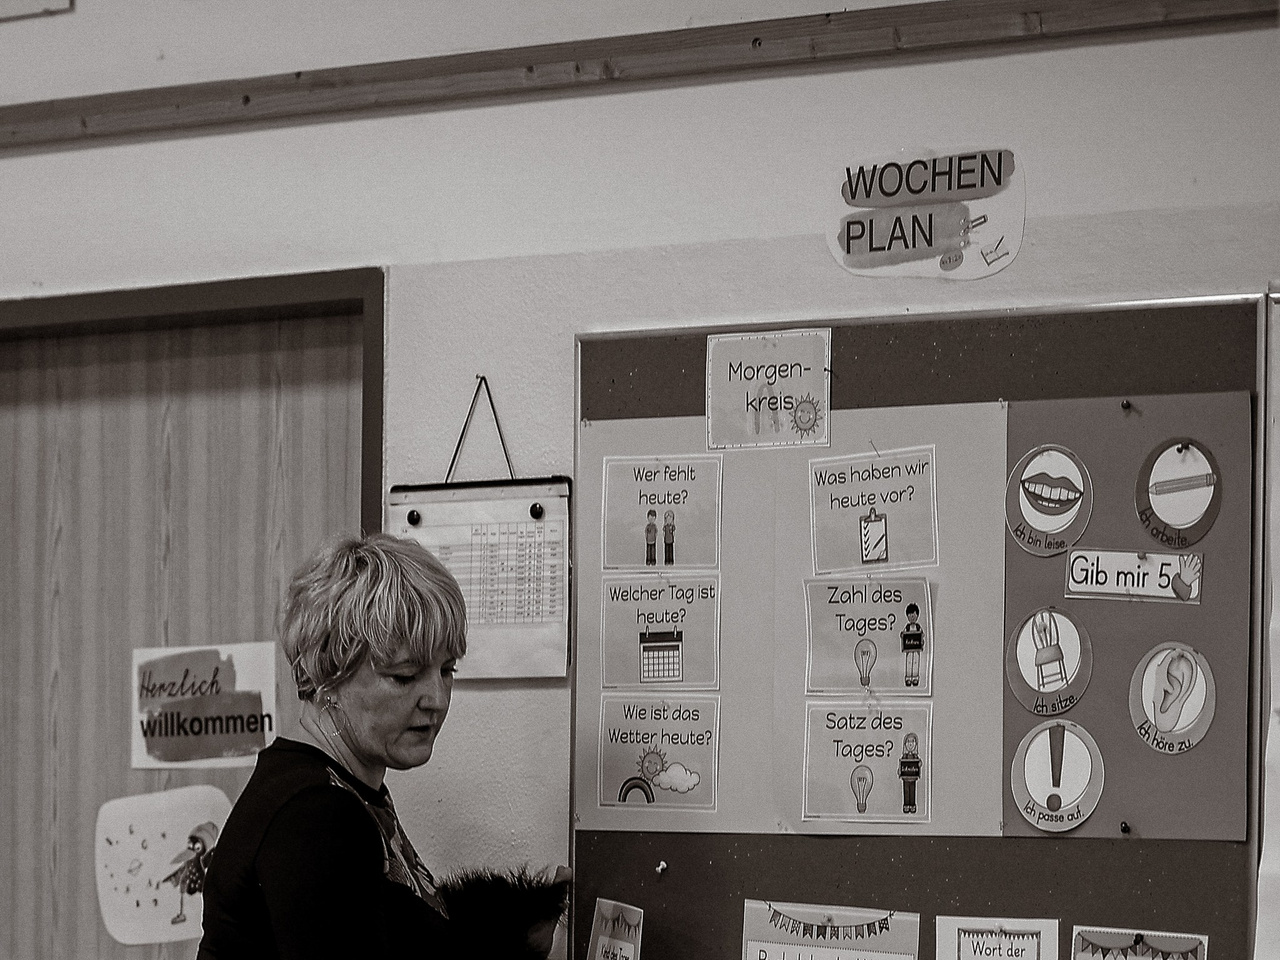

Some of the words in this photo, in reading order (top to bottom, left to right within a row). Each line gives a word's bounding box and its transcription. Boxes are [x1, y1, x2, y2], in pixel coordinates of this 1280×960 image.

[845, 152, 1003, 200] WOCHEN
[846, 213, 933, 254] PLAN
[728, 361, 812, 385] Morgen-
[745, 391, 794, 413] kreis
[633, 466, 660, 482] Wer
[663, 465, 696, 481] fehlt
[814, 471, 847, 487] Was
[850, 463, 901, 482] haben
[904, 460, 929, 476] wir
[638, 489, 688, 505] heute?
[830, 493, 876, 510] heute
[880, 485, 915, 504] vor?
[1013, 522, 1026, 541] Ich
[1027, 530, 1041, 547] bin
[1044, 534, 1068, 550] leise.
[1138, 506, 1154, 529] Ich
[1150, 526, 1190, 547] arbeite.
[1071, 555, 1108, 585] Gib
[1116, 564, 1149, 588] mir
[1158, 562, 1171, 589] 5
[609, 585, 665, 602] Welcher
[668, 585, 694, 603] Tag
[697, 584, 716, 599] ist
[827, 584, 867, 604] Zahl
[871, 584, 903, 603] des
[636, 608, 686, 624] heute?
[835, 613, 896, 636] Tages?
[139, 666, 221, 698] Herzlich
[623, 704, 647, 720] Wie
[650, 705, 669, 721] ist
[671, 704, 700, 721] das
[1033, 697, 1048, 713] Ich
[1051, 694, 1078, 712] sitze.
[140, 711, 273, 738] willkommen
[825, 712, 867, 730] Satz
[871, 711, 903, 730] des
[608, 728, 658, 744] Wetter
[660, 728, 712, 746] heute?
[1137, 720, 1151, 742] Ich
[1151, 730, 1175, 752] höre
[1178, 738, 1194, 752] zu.
[832, 739, 894, 763] Tages?
[1023, 799, 1036, 817] Ich
[1036, 811, 1065, 825] passe
[1067, 804, 1085, 822] auf.
[971, 940, 1002, 957] Wort
[1006, 942, 1026, 958] der
